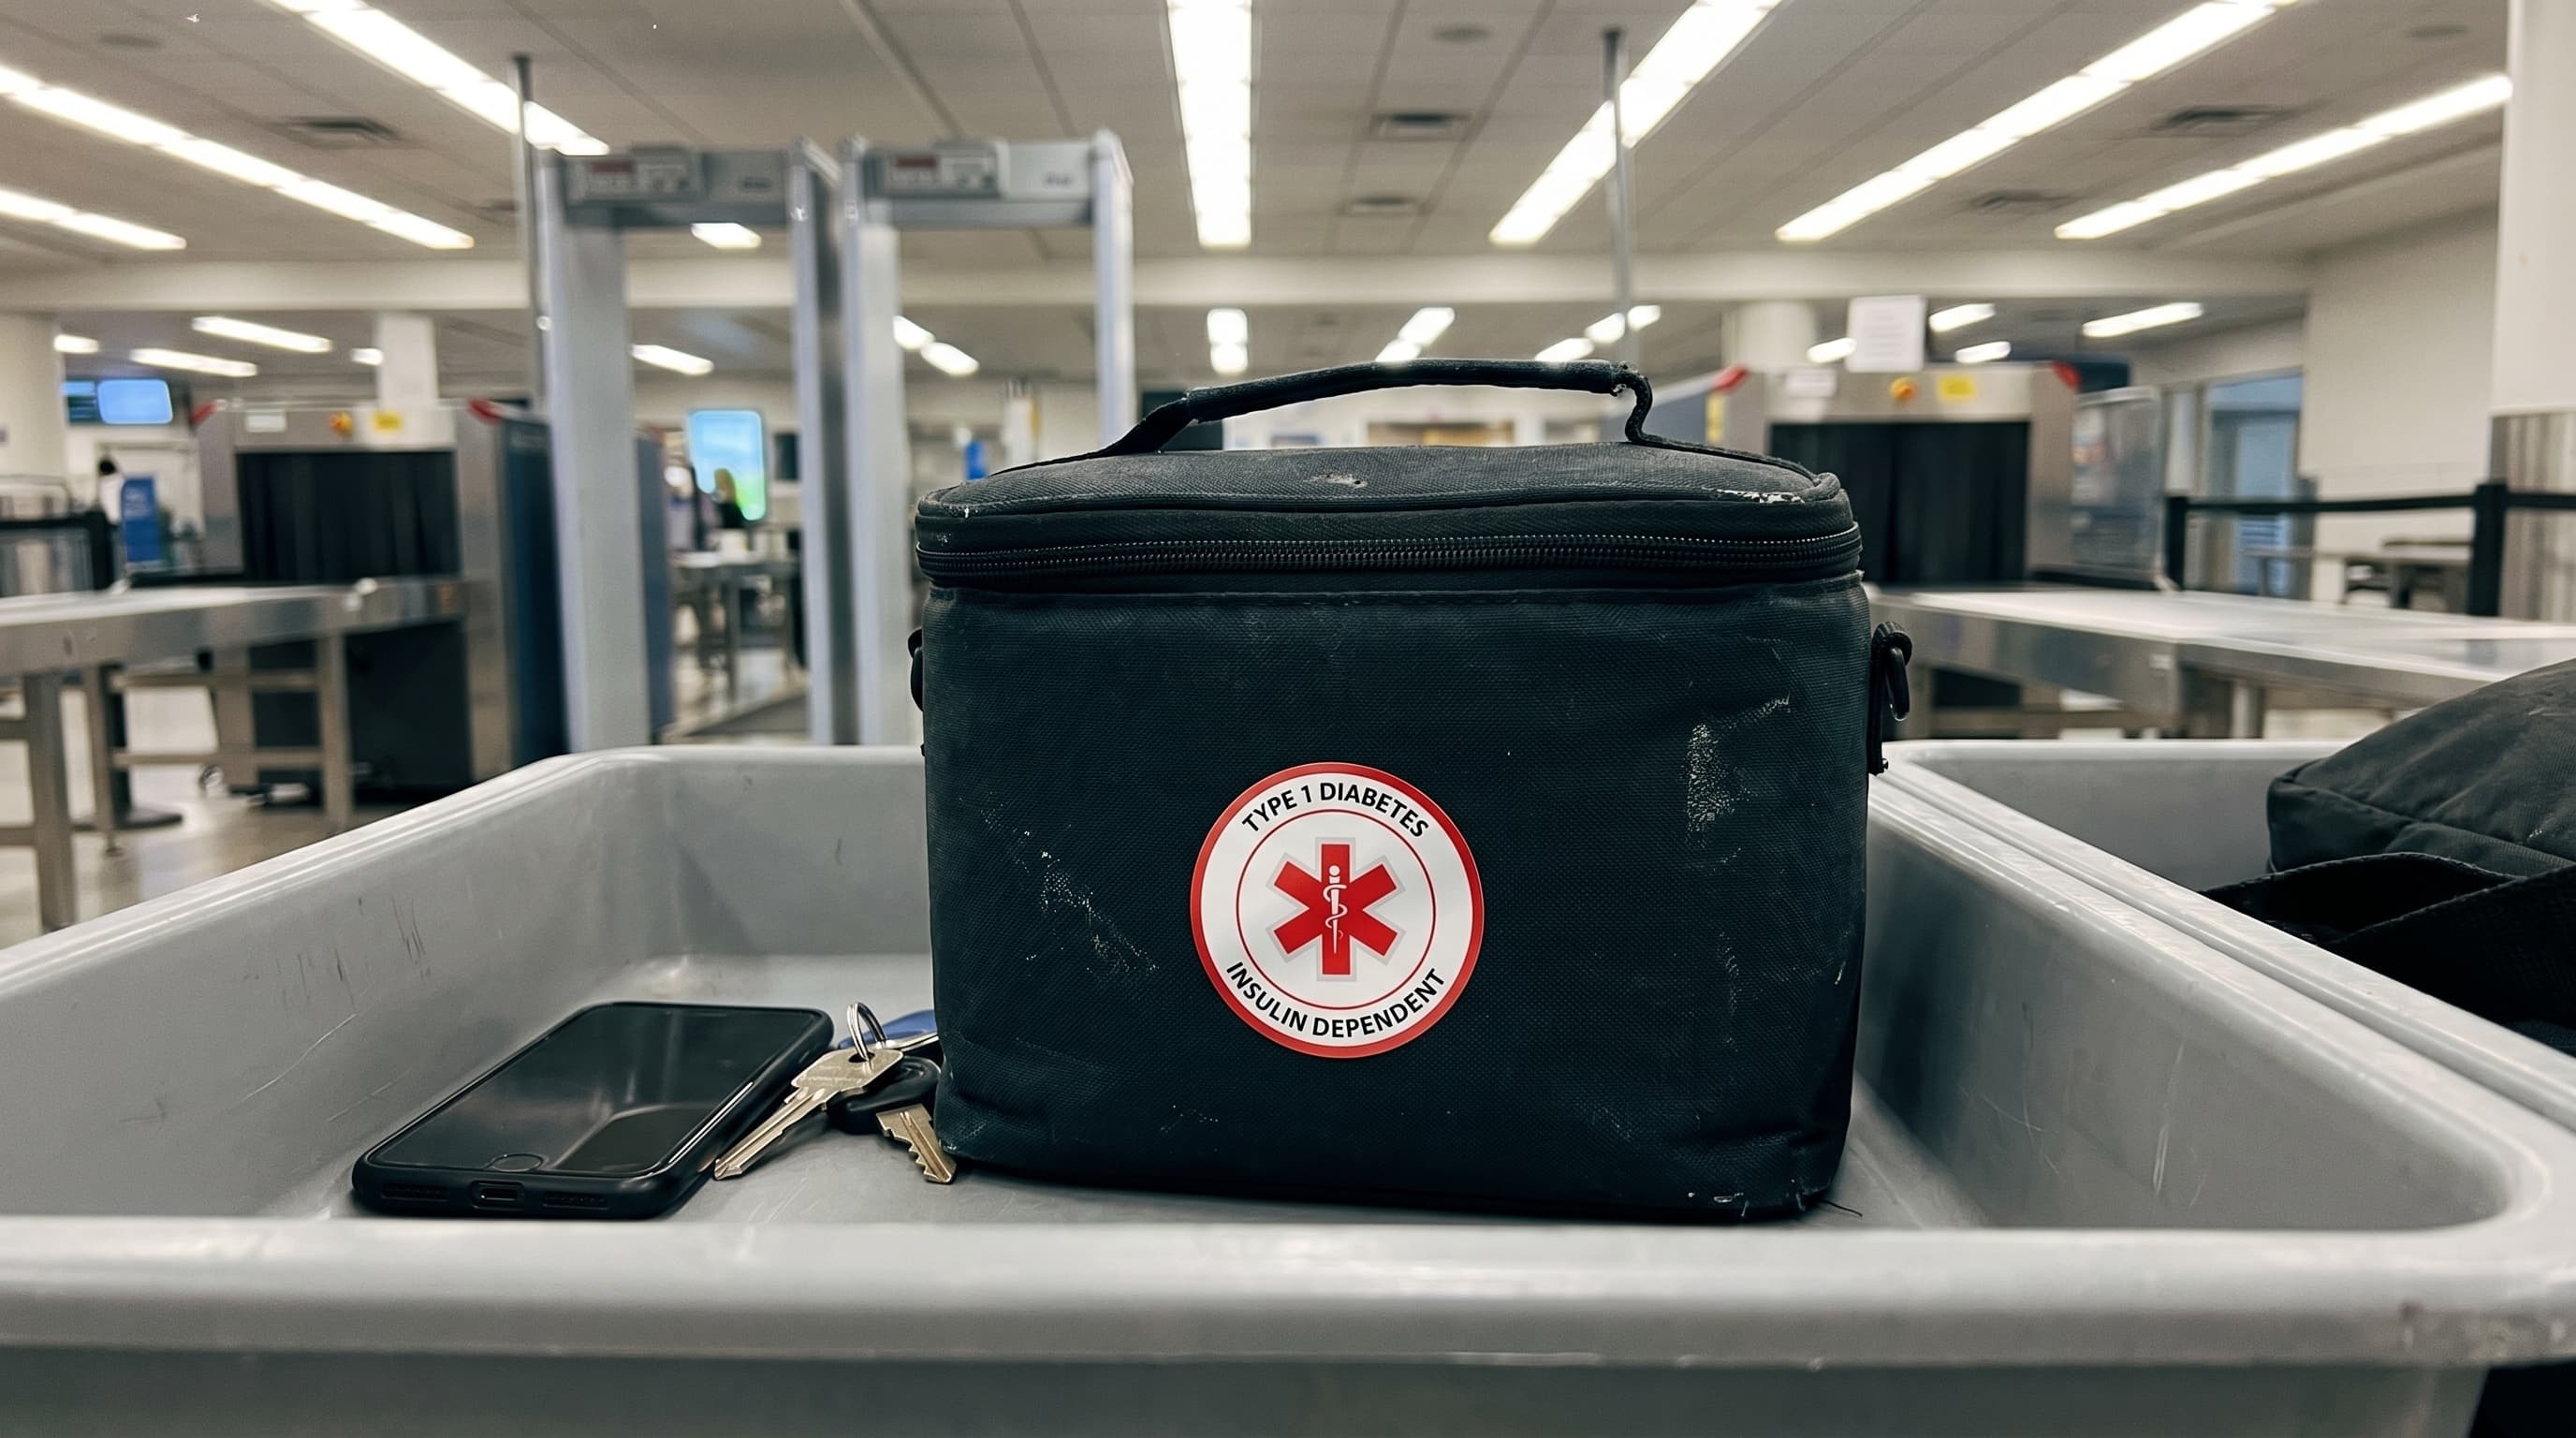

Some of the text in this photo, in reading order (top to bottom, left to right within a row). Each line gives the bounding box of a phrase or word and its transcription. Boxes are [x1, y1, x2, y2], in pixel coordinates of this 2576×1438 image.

[1241, 782, 1429, 837] TYPE 1 DIABETES
[1226, 961, 1444, 1038] INSULIN DEPENDENT
